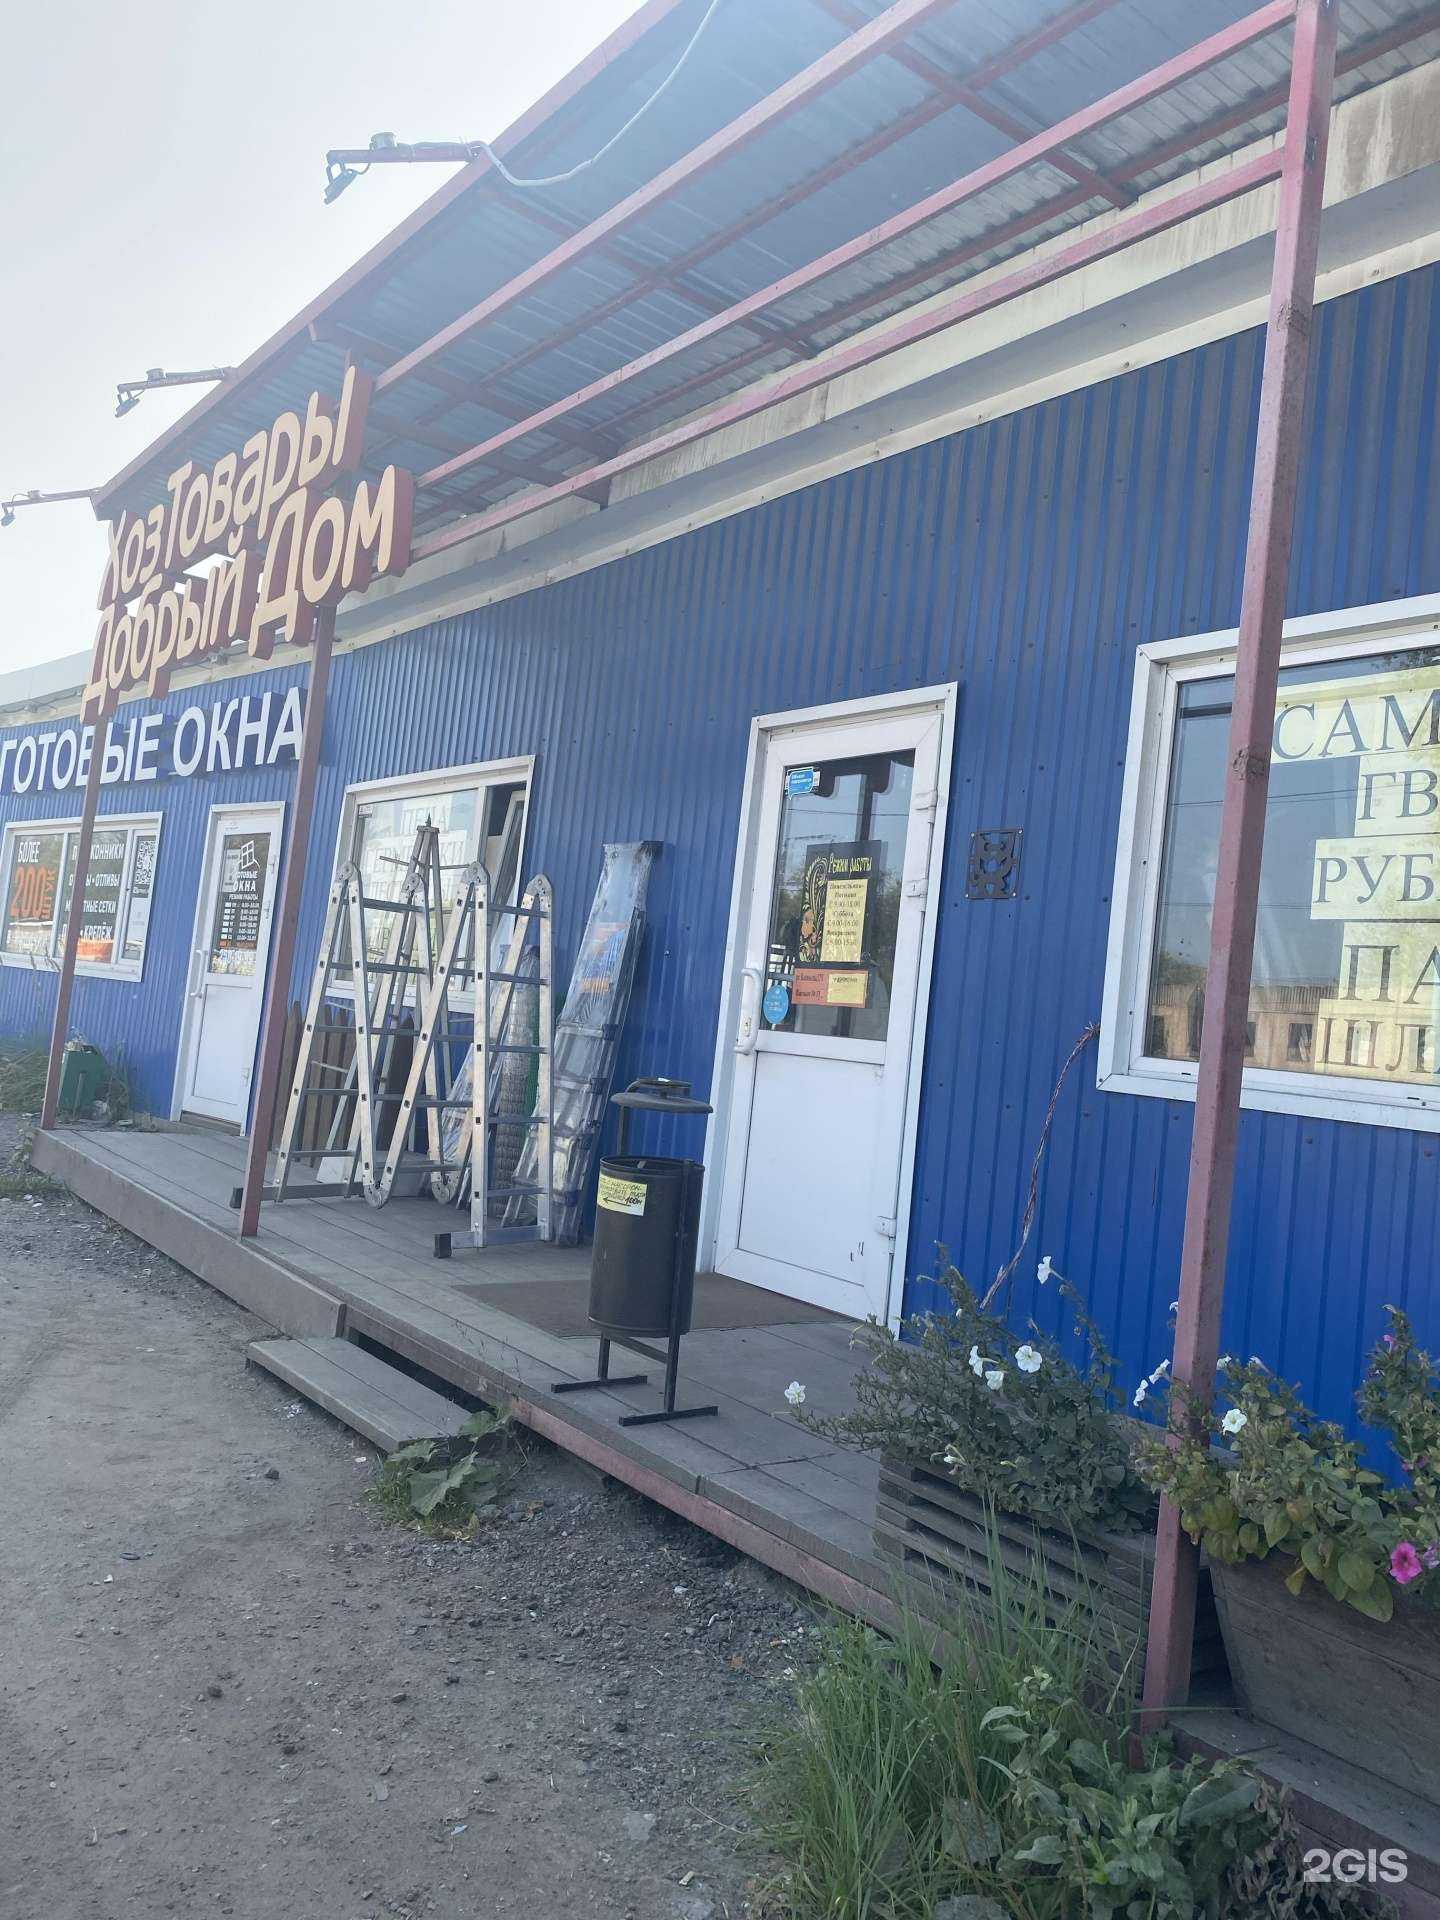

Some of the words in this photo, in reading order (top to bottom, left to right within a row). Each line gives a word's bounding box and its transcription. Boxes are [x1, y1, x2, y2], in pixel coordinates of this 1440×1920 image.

[0, 713, 163, 794] ГОТОВЫЕ
[173, 687, 302, 778] ОКНА
[1272, 687, 1440, 760] САМ
[18, 841, 41, 863] БОЛЕЕ
[1313, 853, 1440, 905] РУБ
[10, 864, 48, 918] 200
[232, 881, 257, 892] ОКНА
[1319, 1017, 1440, 1074] ШЛ
